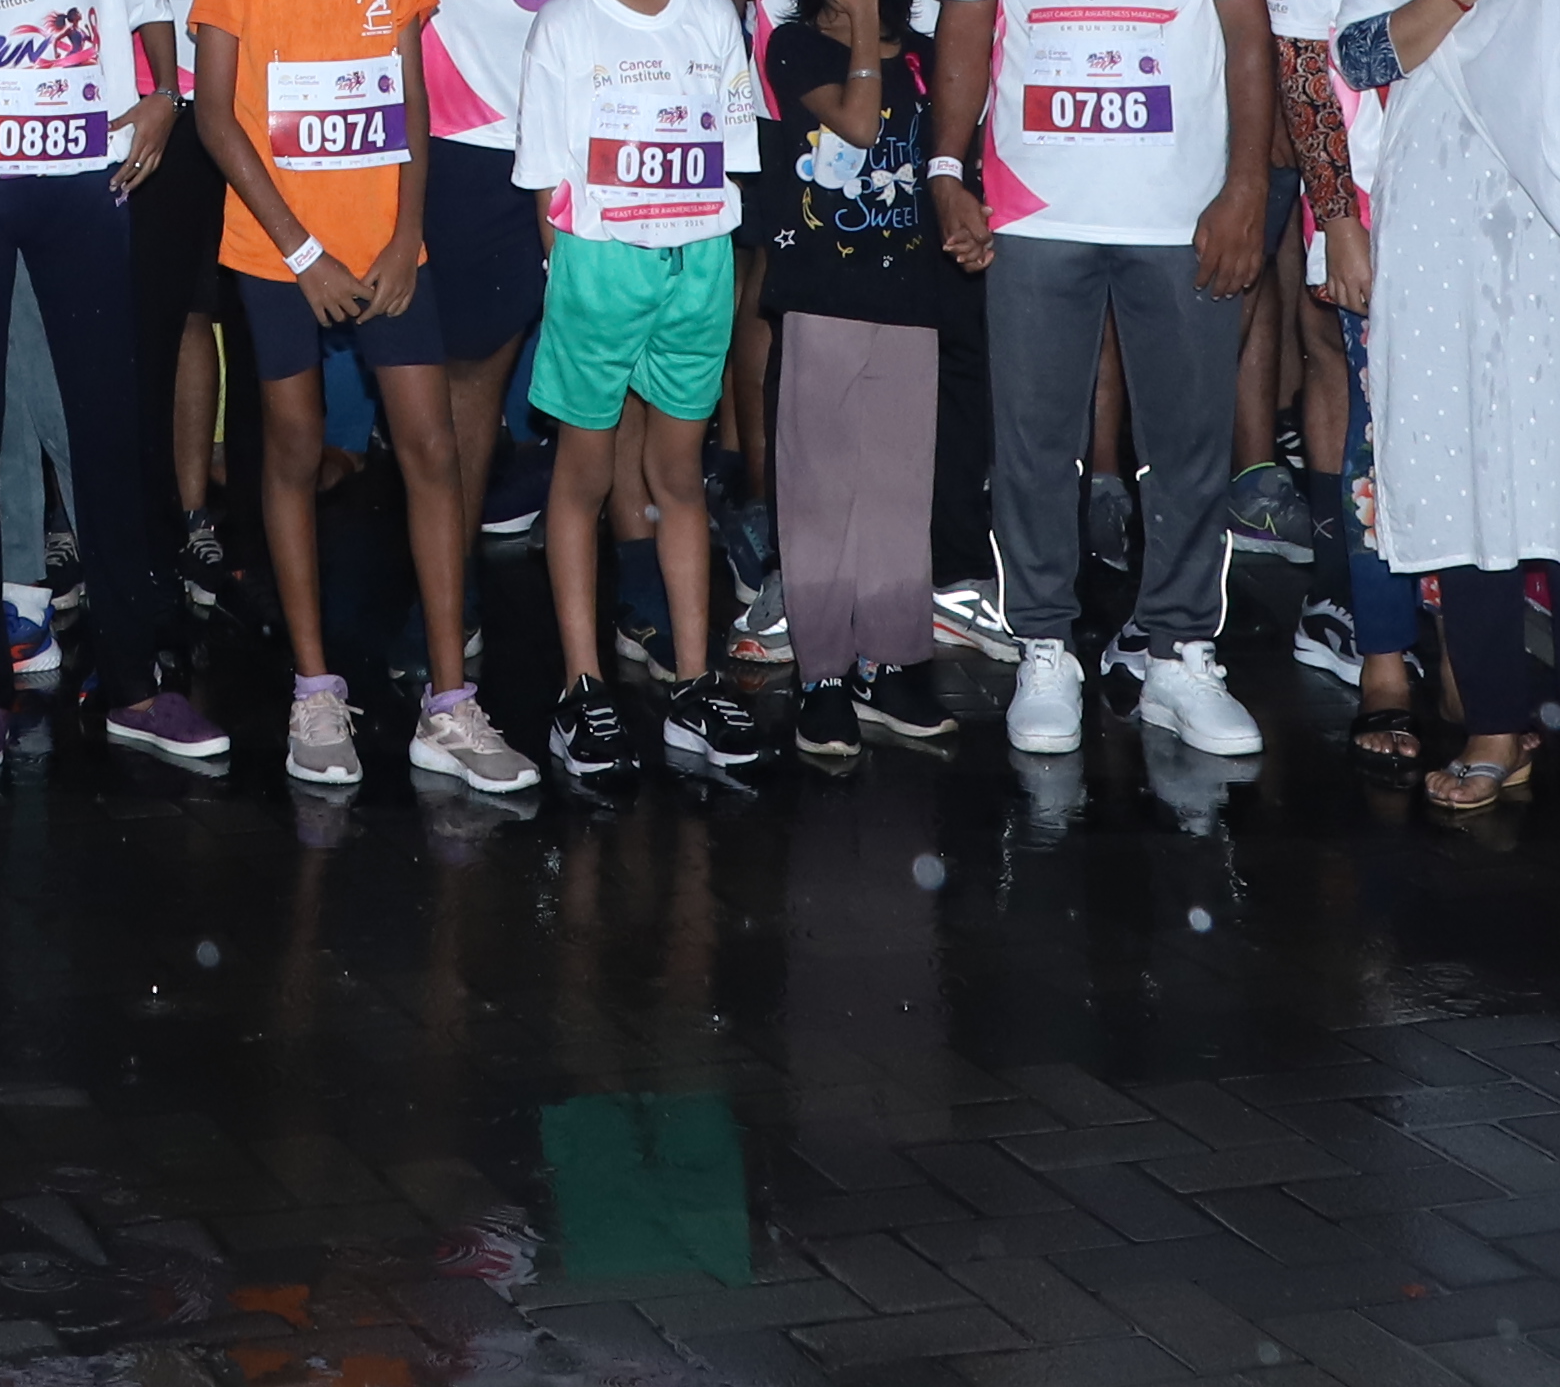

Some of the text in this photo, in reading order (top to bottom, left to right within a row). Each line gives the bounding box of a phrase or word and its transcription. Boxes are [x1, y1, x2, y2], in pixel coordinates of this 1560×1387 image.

[1050, 90, 1149, 129] 0786
[299, 111, 386, 153] 0974
[617, 146, 705, 184] 0810
